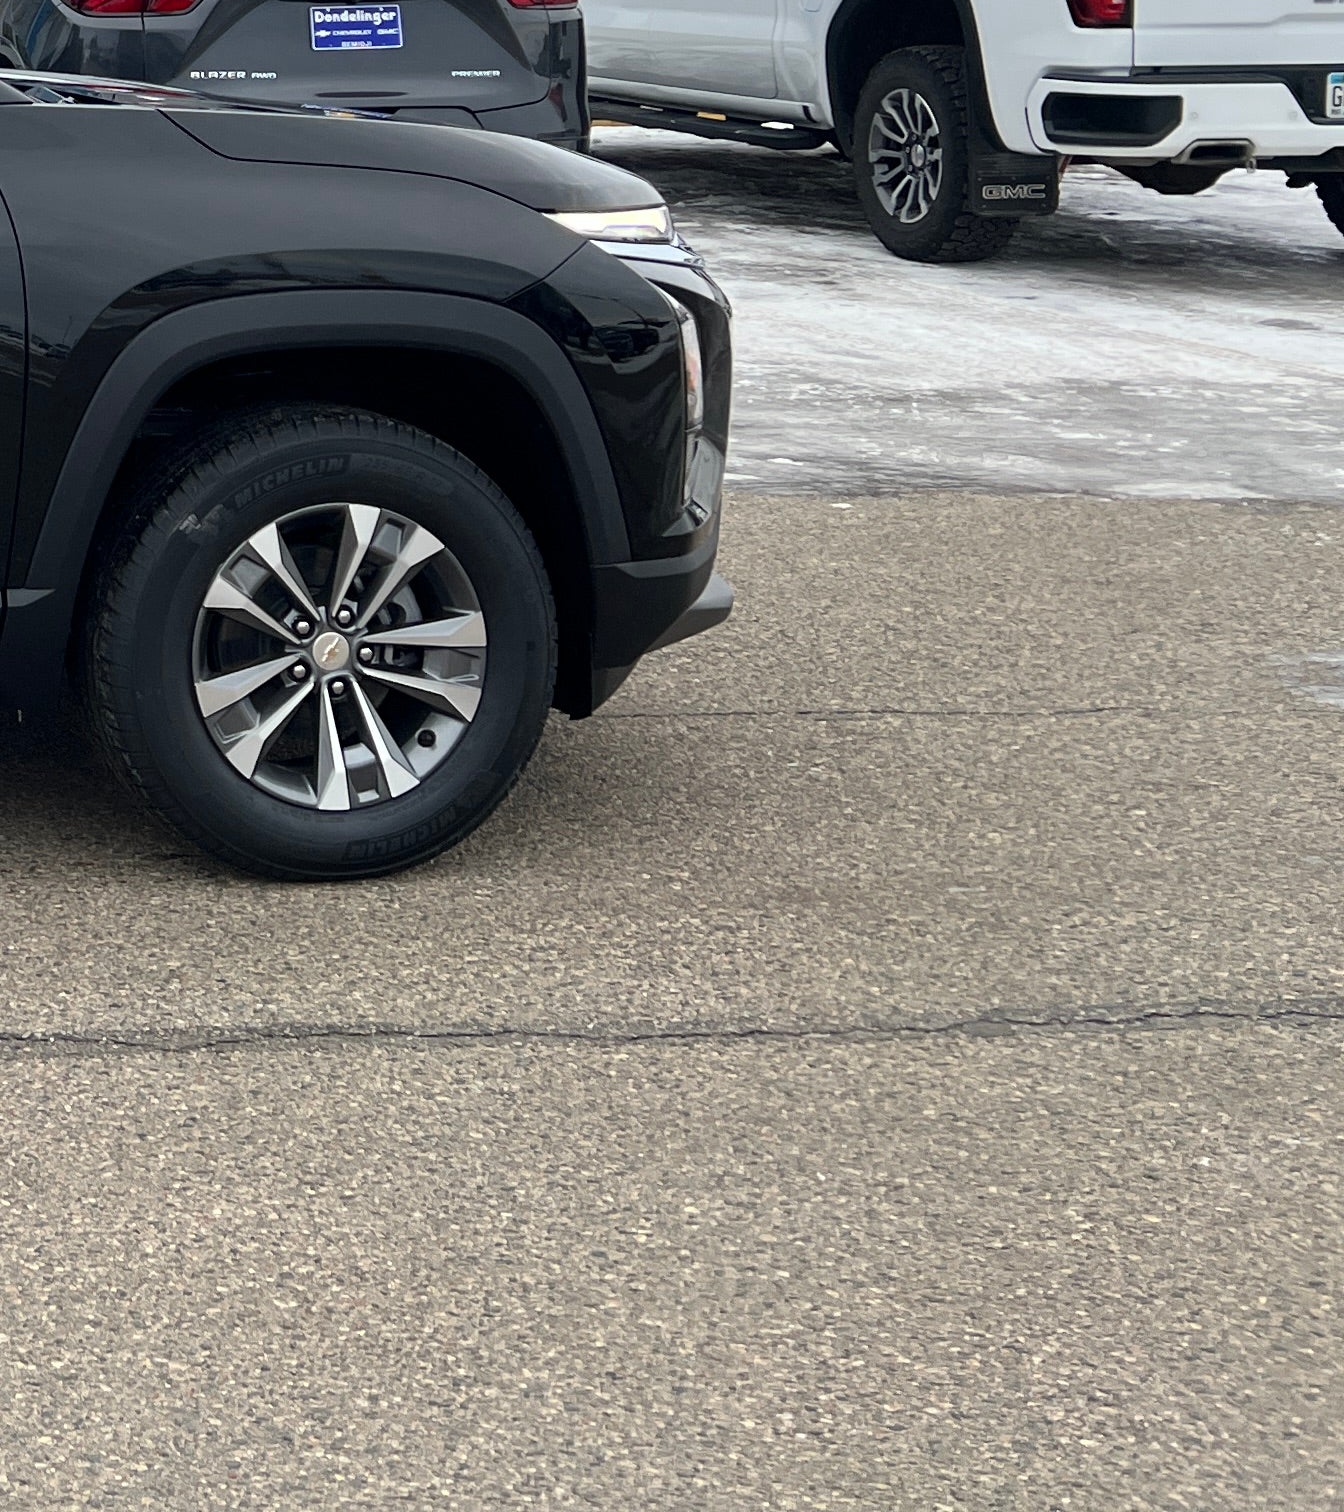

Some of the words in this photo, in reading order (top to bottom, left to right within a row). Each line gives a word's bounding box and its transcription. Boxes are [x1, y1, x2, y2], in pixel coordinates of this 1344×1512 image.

[314, 9, 397, 26] Dondelinger
[190, 71, 246, 80] BLAZER
[982, 184, 1046, 200] GMC
[234, 457, 345, 510] MICHELIN
